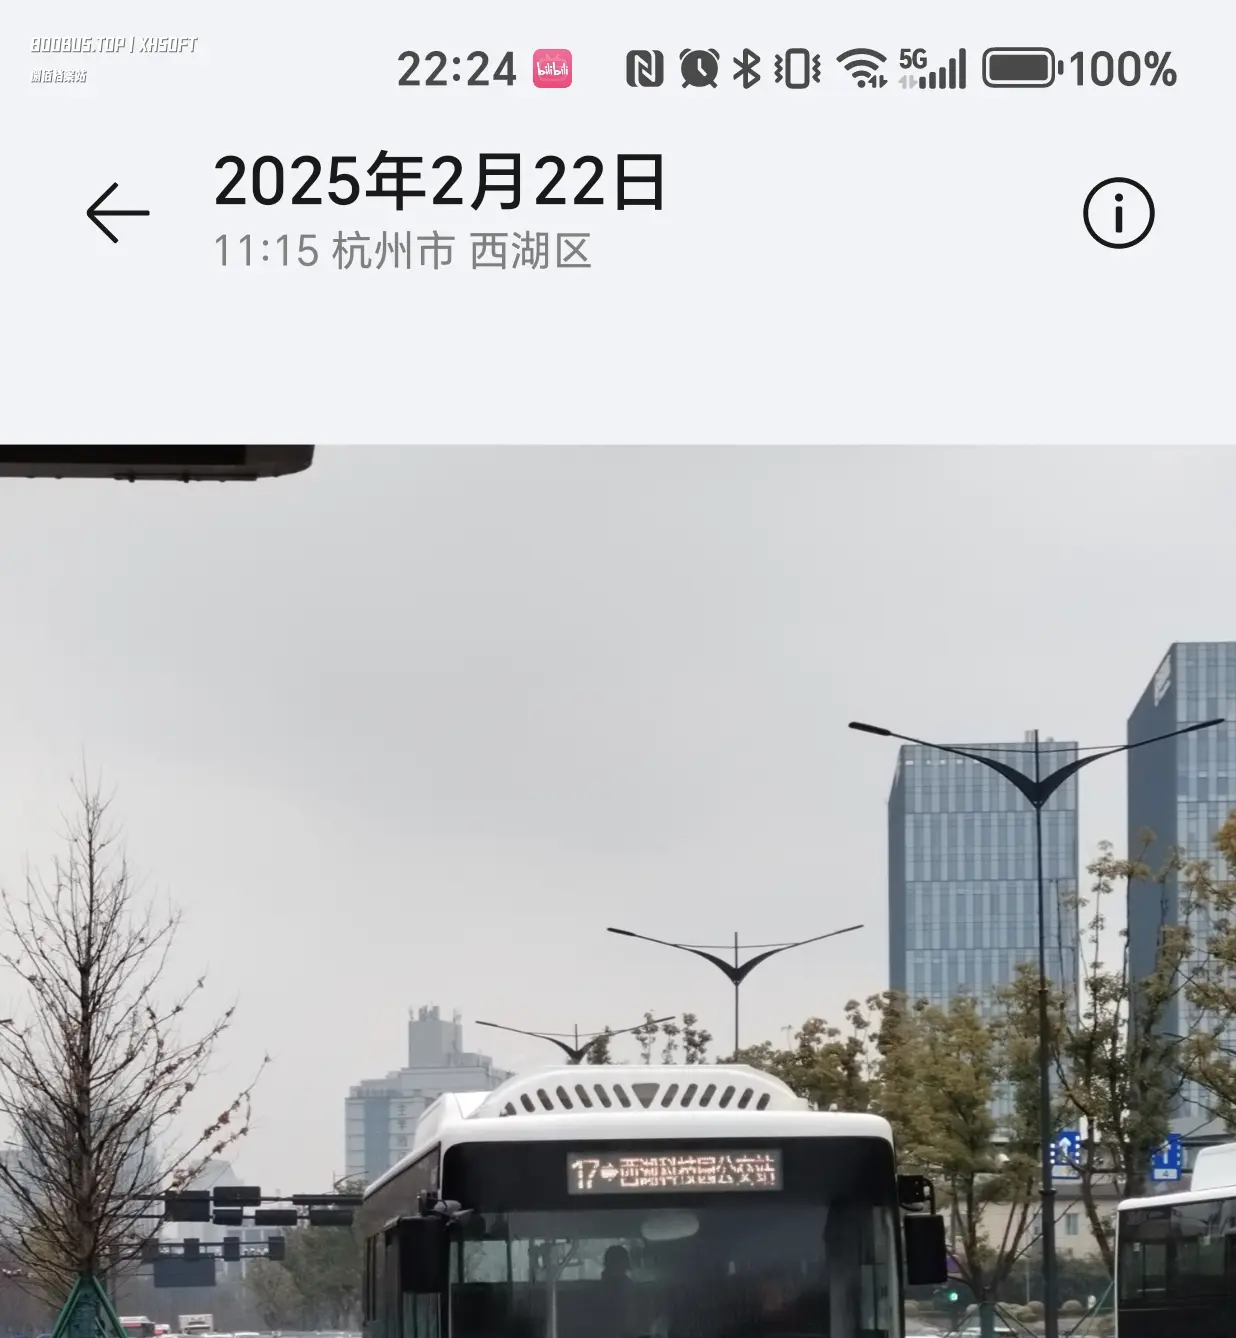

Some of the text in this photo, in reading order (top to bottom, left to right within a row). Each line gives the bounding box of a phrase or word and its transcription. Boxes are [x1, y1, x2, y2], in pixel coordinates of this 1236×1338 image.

[398, 51, 516, 86] 22:24
[536, 61, 570, 78] bilibili
[900, 48, 927, 69] 5G
[1071, 51, 1177, 86] 100%
[215, 150, 662, 211] 2025年2月22日
[216, 230, 591, 270] 11:15 杭州市 西湖区
[572, 1158, 600, 1190] 17
